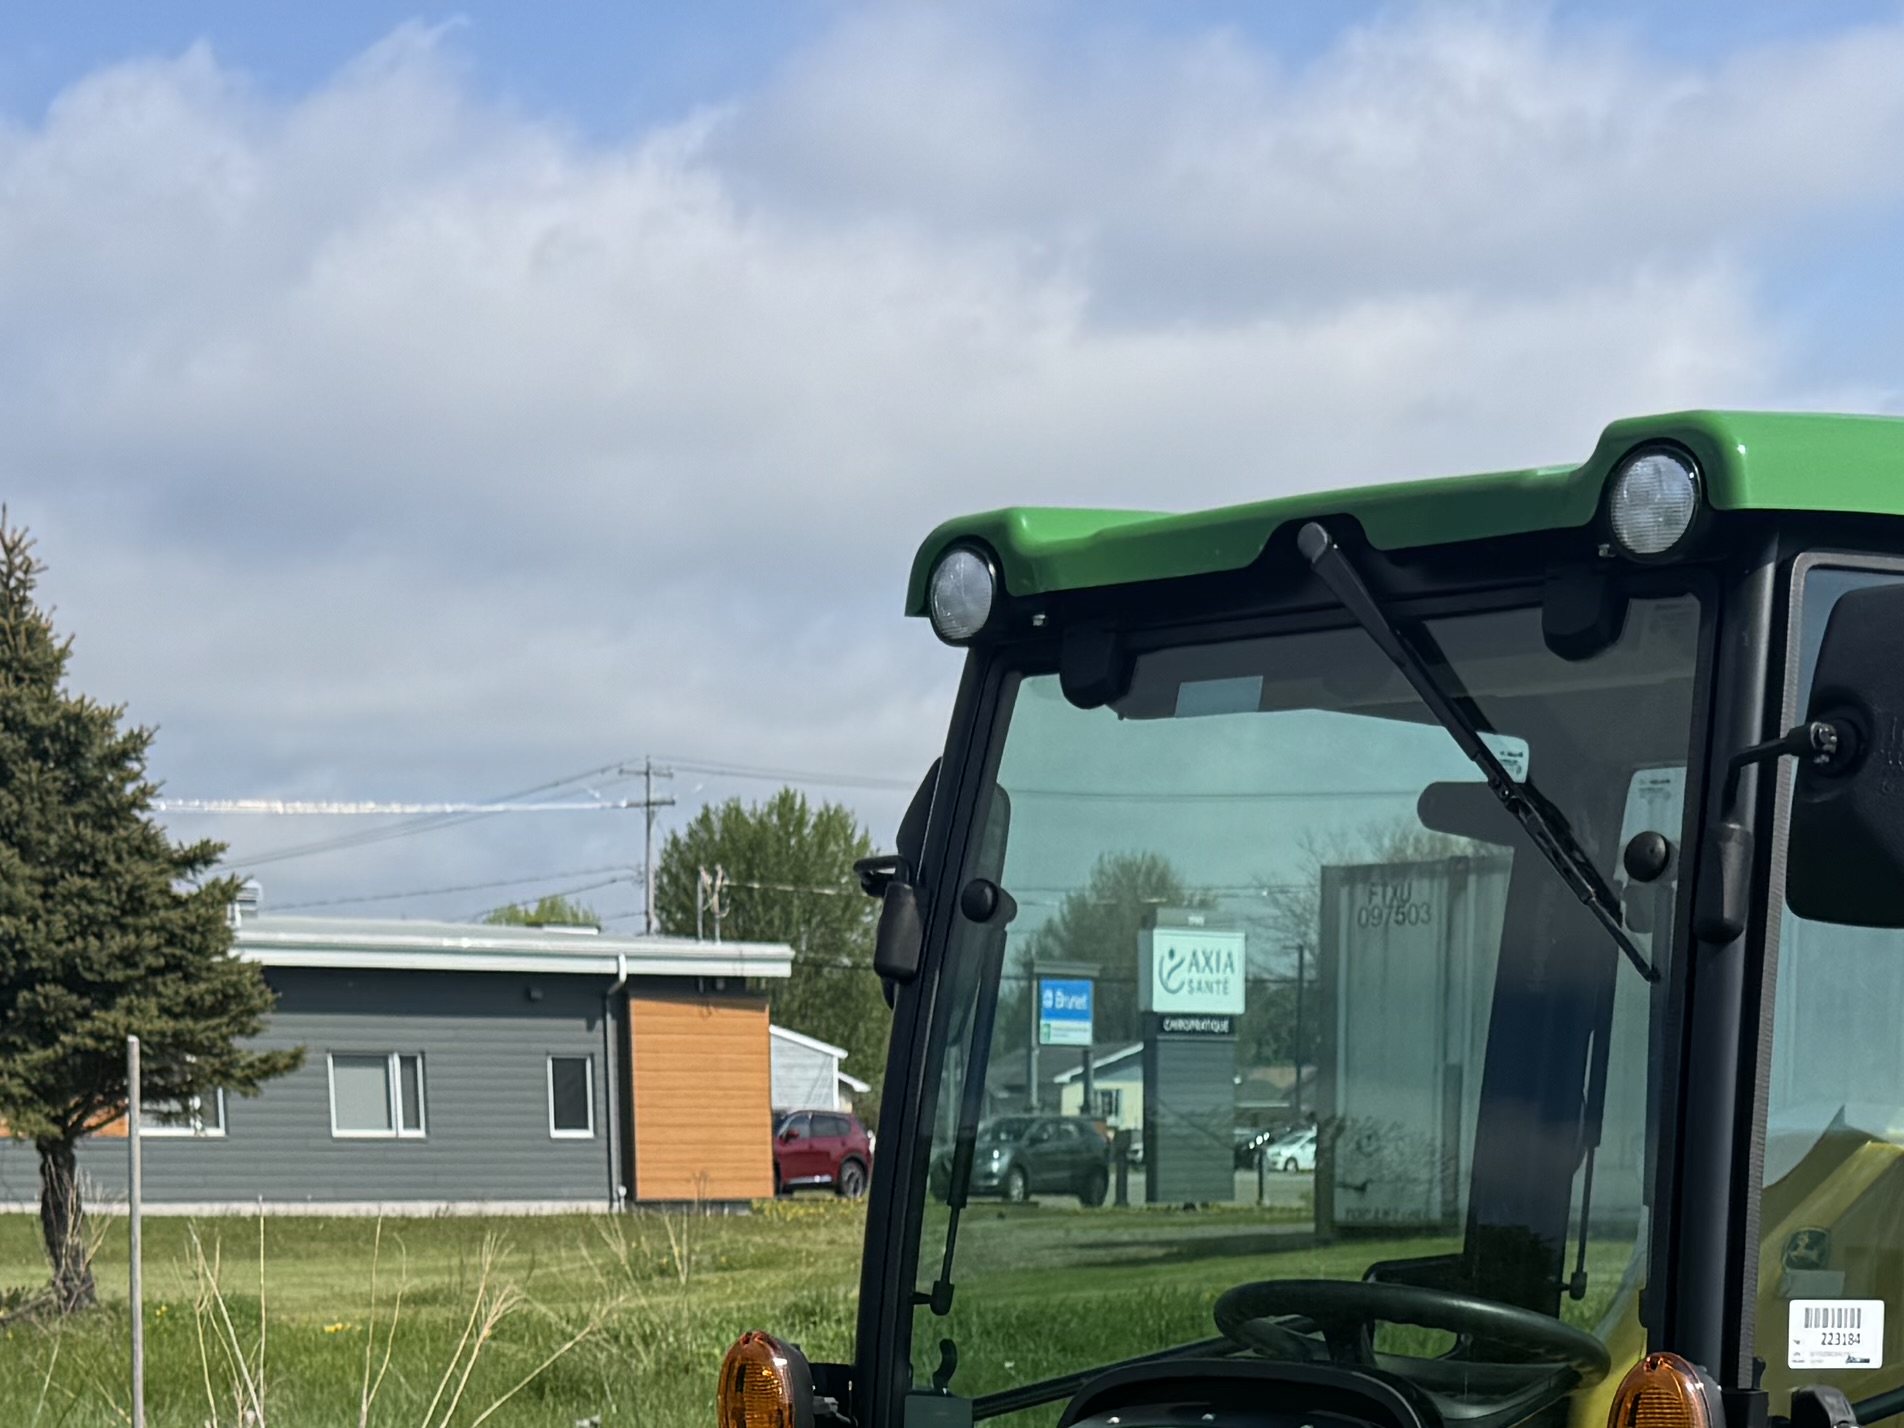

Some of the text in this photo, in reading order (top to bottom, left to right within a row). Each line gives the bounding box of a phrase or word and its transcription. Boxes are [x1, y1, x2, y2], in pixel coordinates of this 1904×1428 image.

[1367, 881, 1412, 906] FTXU
[1187, 949, 1236, 975] AXIA
[1820, 1332, 1861, 1346] 223184
